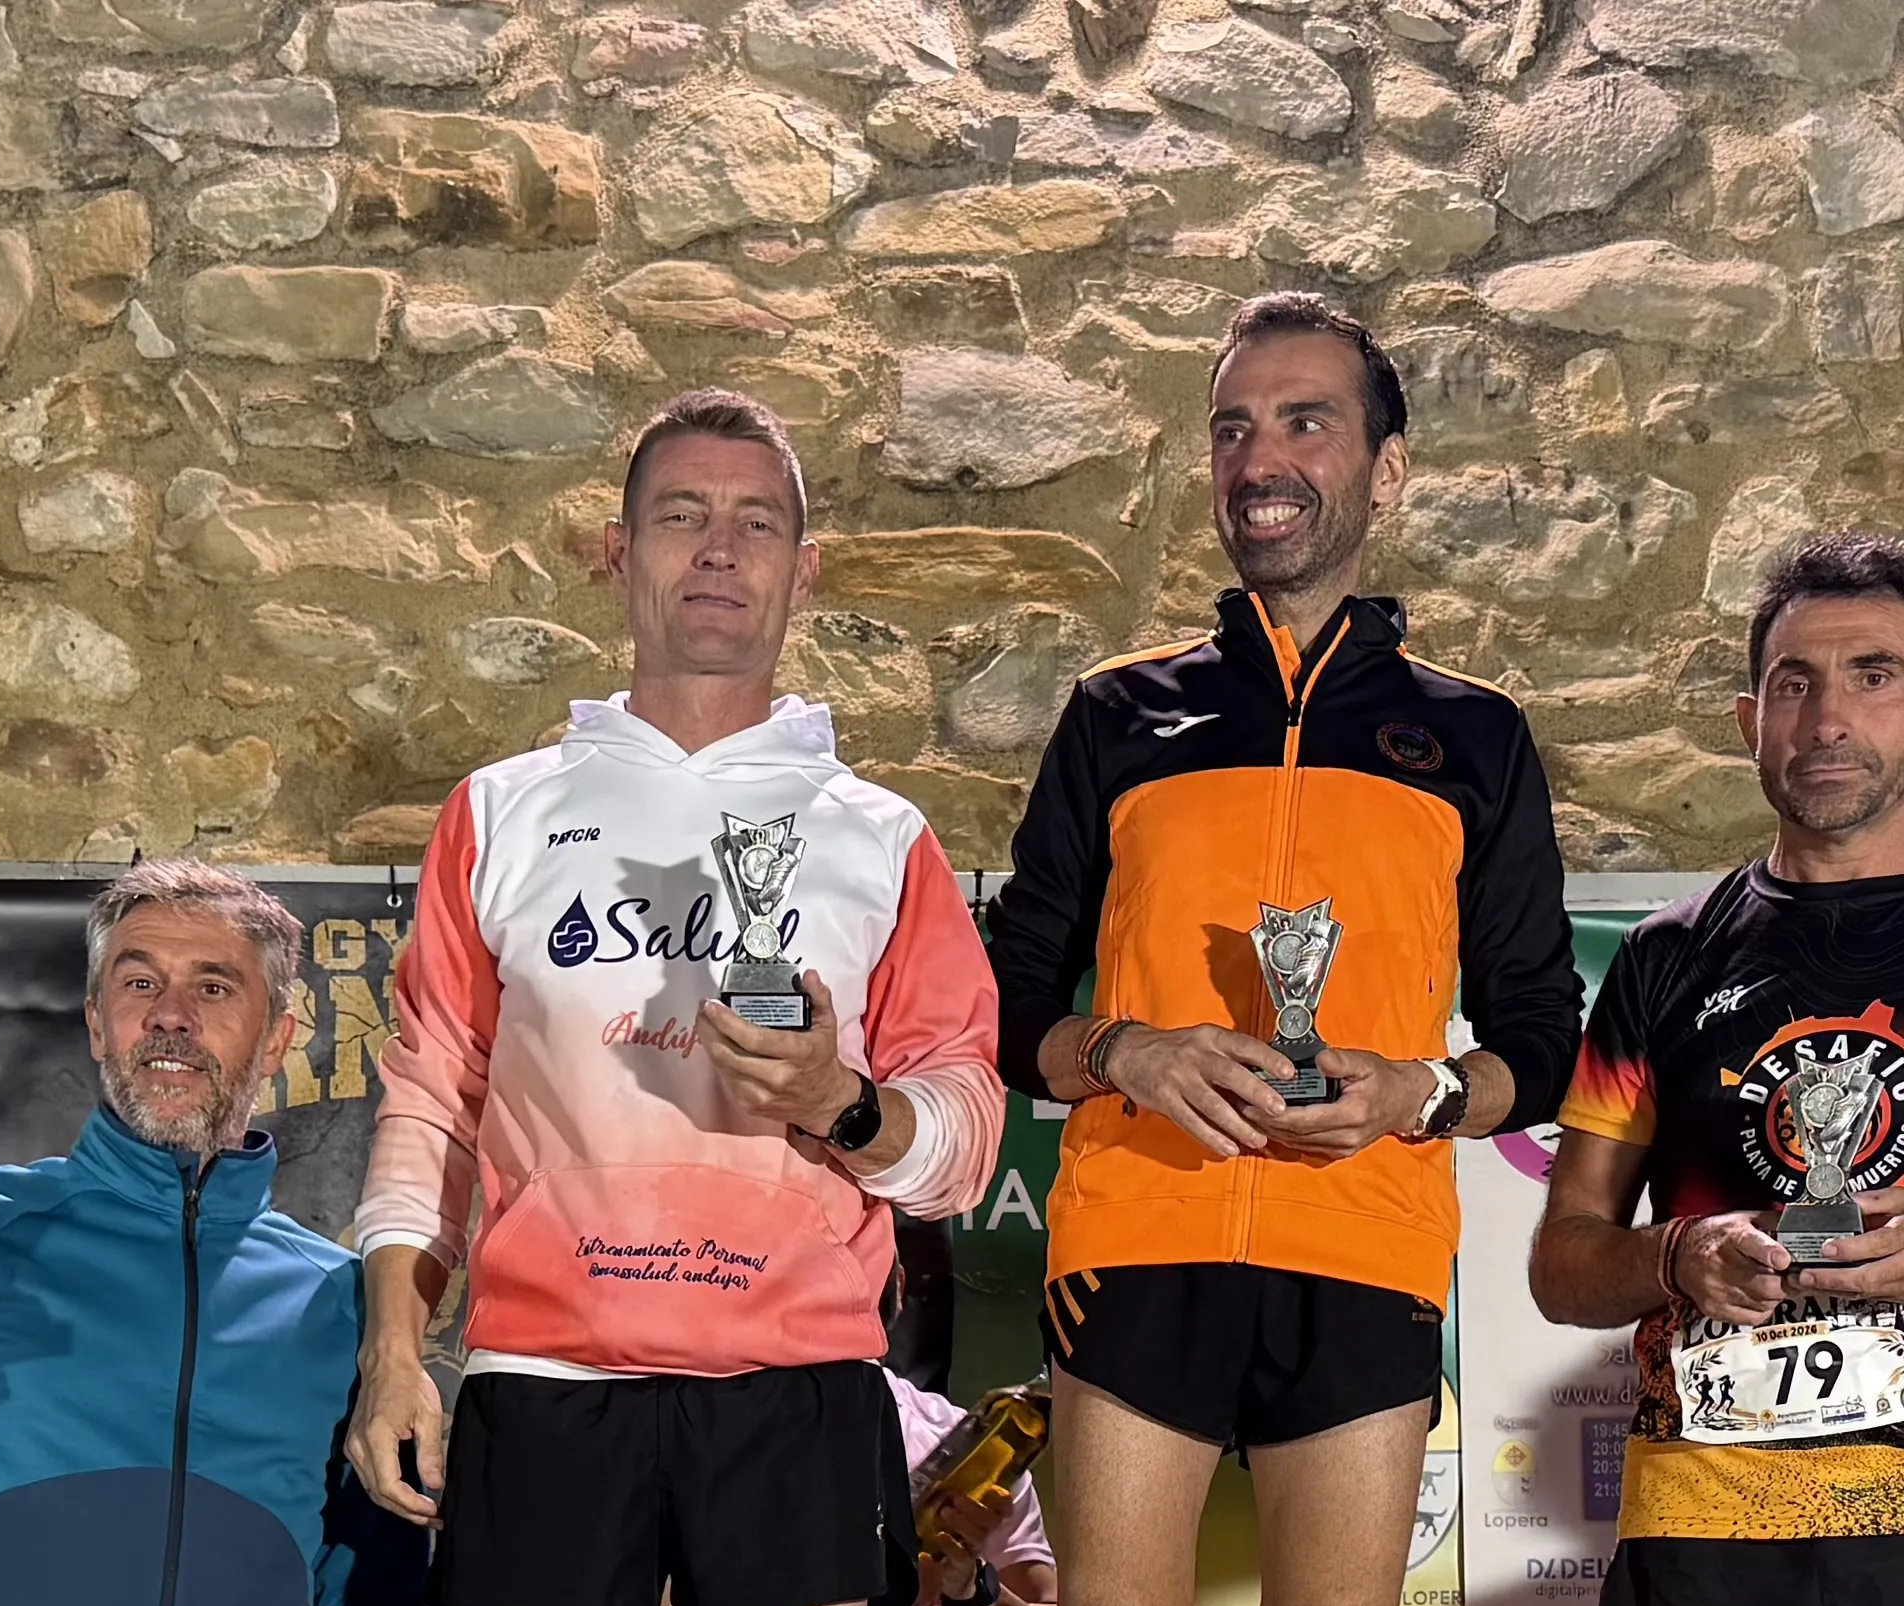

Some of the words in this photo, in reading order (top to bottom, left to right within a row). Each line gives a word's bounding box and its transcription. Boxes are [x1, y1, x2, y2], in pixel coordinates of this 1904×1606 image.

[602, 1011, 702, 1058] Andúj
[1740, 1128, 1772, 1181] PLAYA
[1772, 1174, 1798, 1197] DE
[696, 1237, 768, 1272] Personal
[1681, 1296, 1827, 1352] LORA
[1756, 1331, 1767, 1342] 10
[1768, 1341, 1844, 1406] 79
[1592, 1461, 1621, 1474] 20:3
[1485, 1513, 1549, 1529] Lopera
